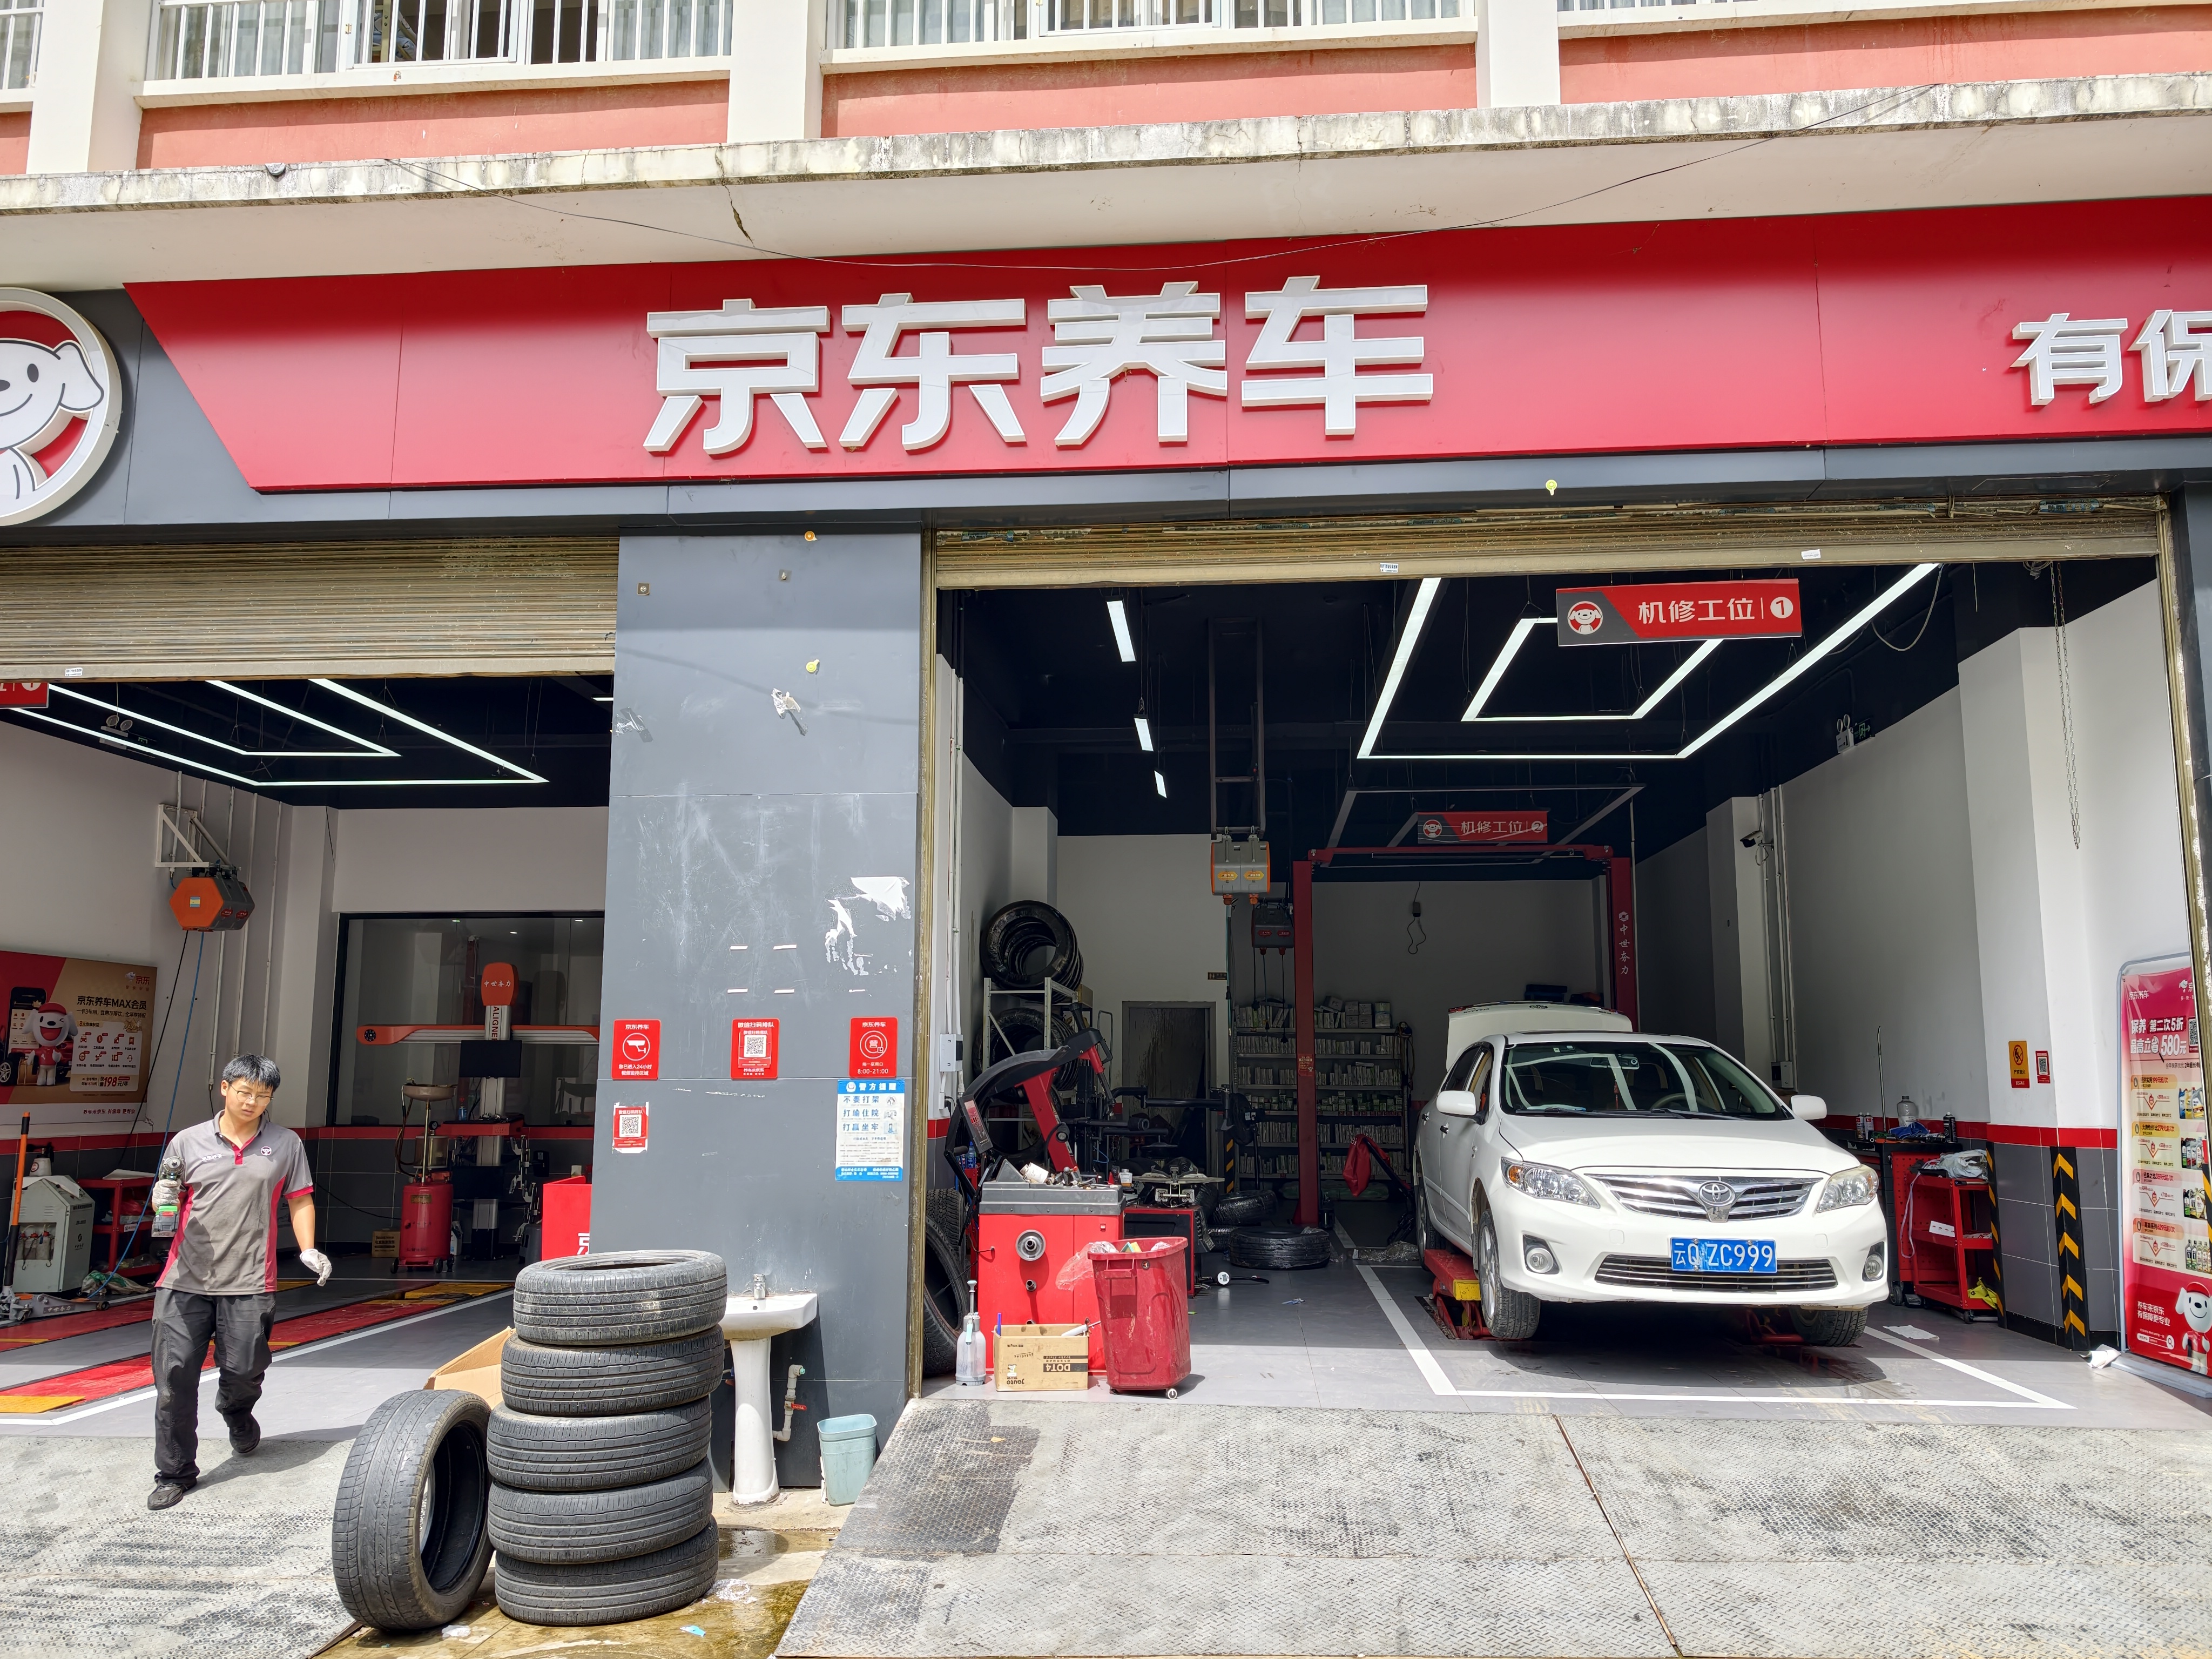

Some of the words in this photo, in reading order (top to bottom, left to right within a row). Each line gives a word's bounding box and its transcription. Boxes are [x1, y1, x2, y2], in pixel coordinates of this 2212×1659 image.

[643, 275, 1435, 456] 京东养车
[1638, 598, 1755, 624] 机修工位
[1461, 820, 1523, 834] 机修工位
[136, 976, 150, 986] 京东
[2129, 990, 2149, 1000] 京东养车
[77, 995, 147, 1010] 京东养车MAX会员
[2130, 1018, 2147, 1034] 保养
[2149, 1017, 2183, 1033] 第二次5折
[2130, 1034, 2187, 1056] 最高立省580元
[104, 1076, 117, 1087] 198
[859, 1082, 896, 1091] 警方提醒
[843, 1109, 879, 1117] 打输住院
[842, 1123, 879, 1131] 打赢坐牢
[1046, 1364, 1070, 1372] DOT4
